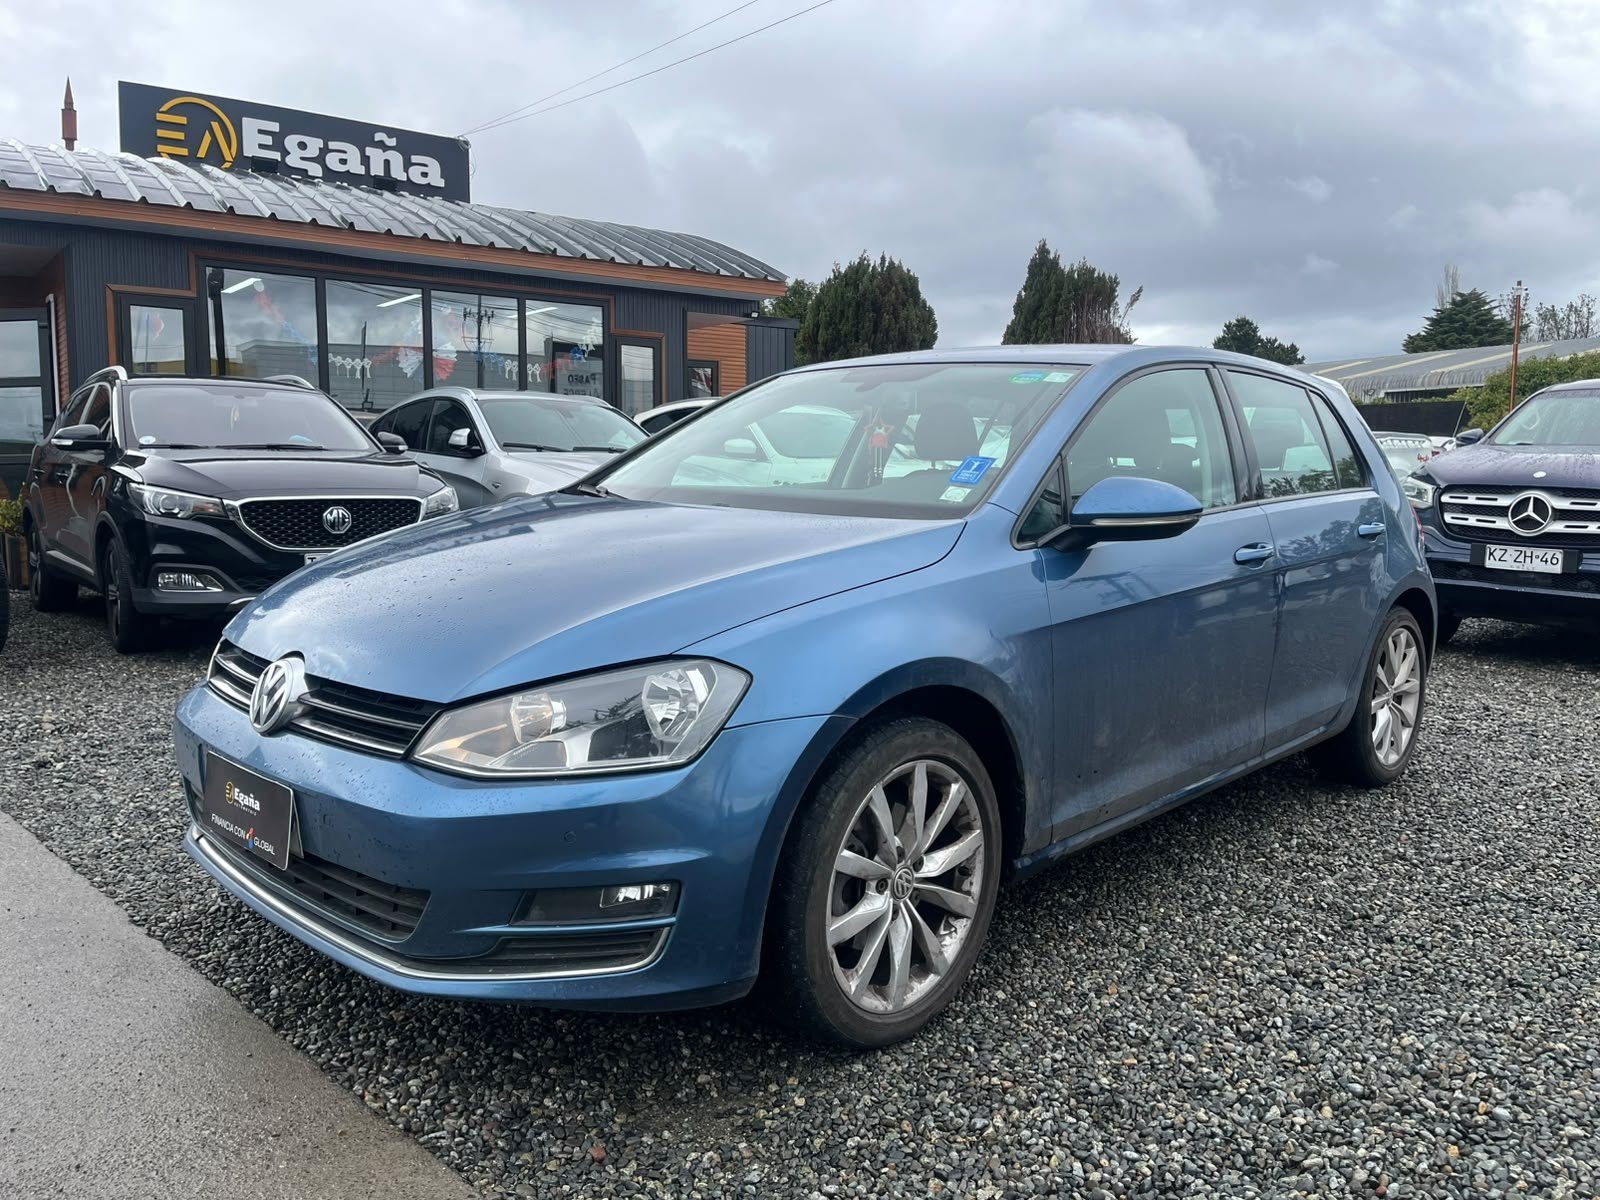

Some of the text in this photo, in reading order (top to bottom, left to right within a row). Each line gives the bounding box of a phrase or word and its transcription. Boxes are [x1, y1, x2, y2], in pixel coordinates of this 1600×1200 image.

[242, 117, 445, 188] Egaña
[325, 508, 350, 532] MG
[234, 787, 261, 811] Egaña
[253, 837, 276, 856] GLOBAL
